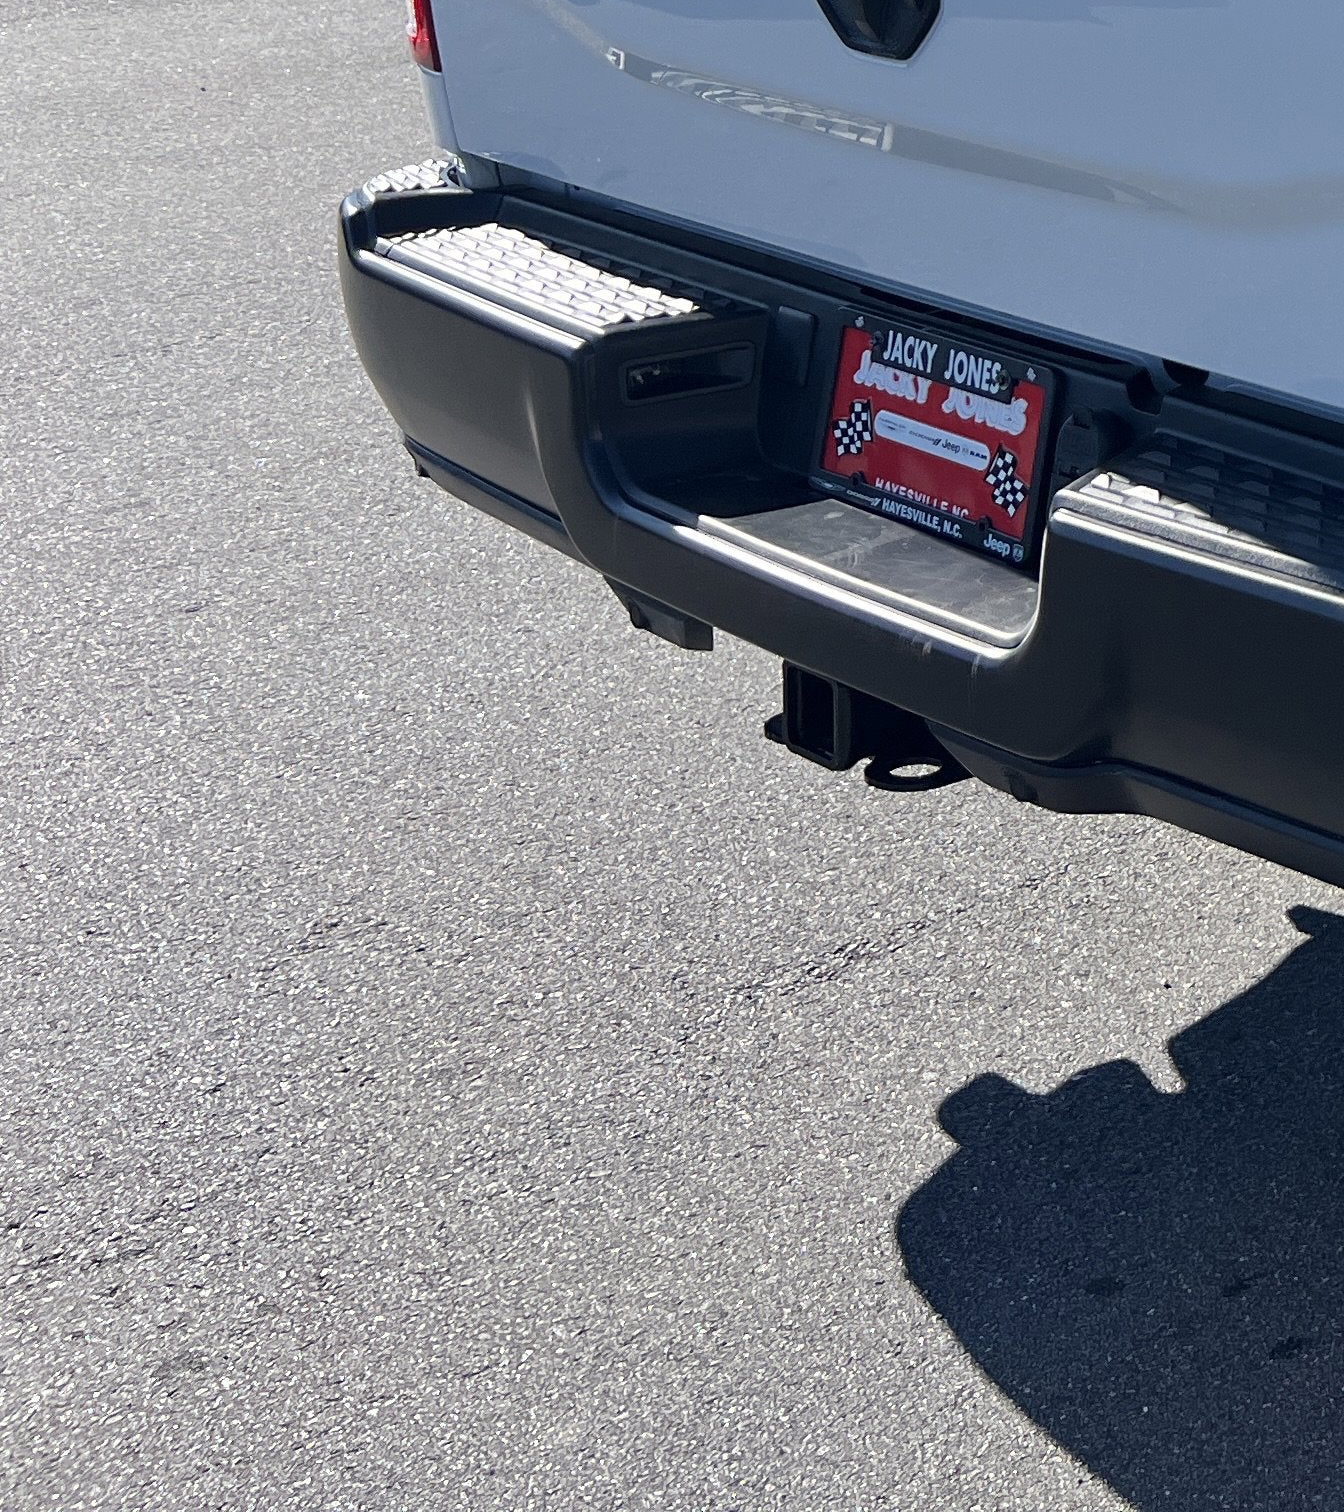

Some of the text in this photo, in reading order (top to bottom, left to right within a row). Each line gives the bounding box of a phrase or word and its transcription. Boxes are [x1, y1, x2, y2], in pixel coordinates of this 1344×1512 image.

[883, 330, 1002, 394] JACKY JONES
[942, 438, 961, 454] Jeep
[881, 497, 941, 532] HAYESVILLE,
[983, 533, 1010, 557] Jeep
